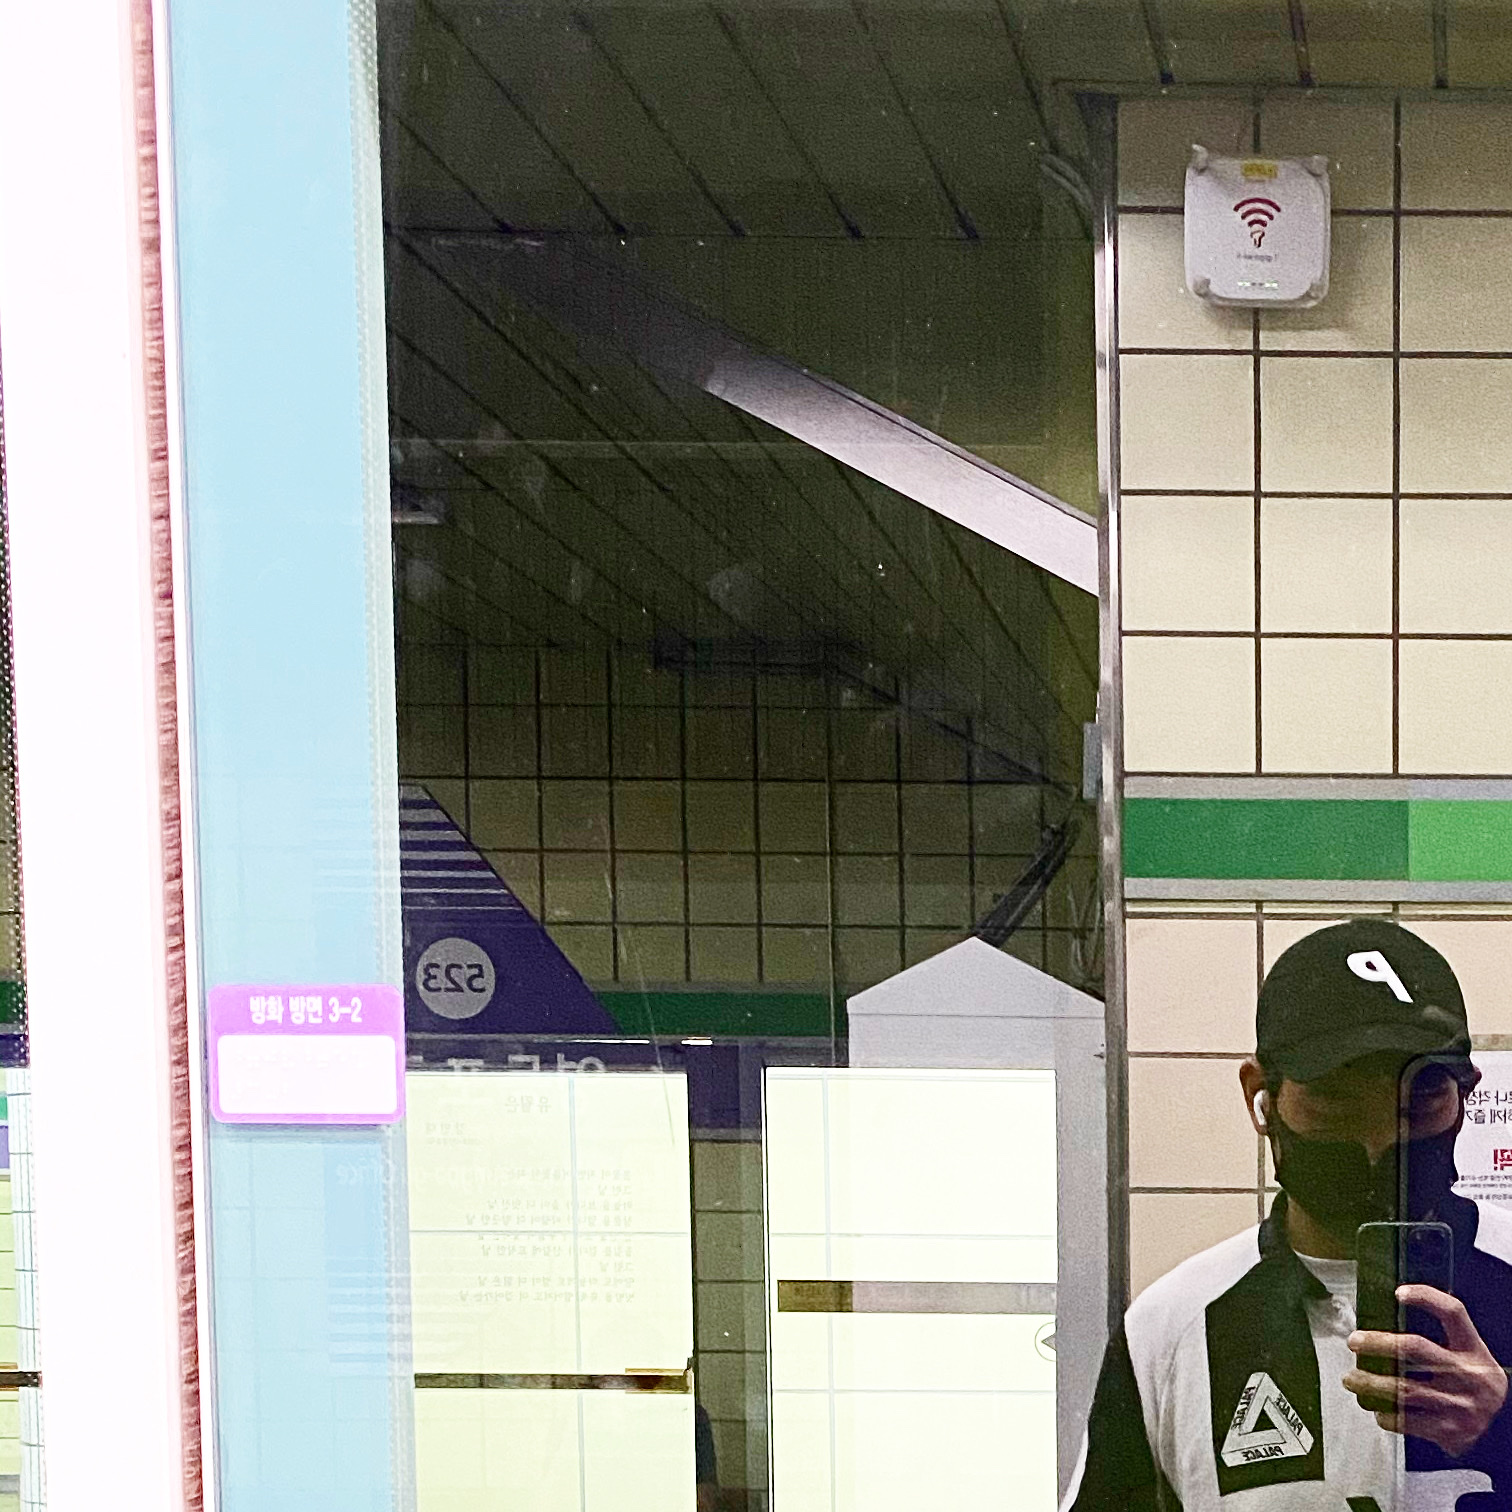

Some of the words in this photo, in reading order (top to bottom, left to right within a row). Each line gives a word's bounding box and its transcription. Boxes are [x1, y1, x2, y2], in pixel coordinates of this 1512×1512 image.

[250, 996, 284, 1024] 방화
[289, 996, 323, 1024] 방면
[328, 997, 363, 1023] 3-2
